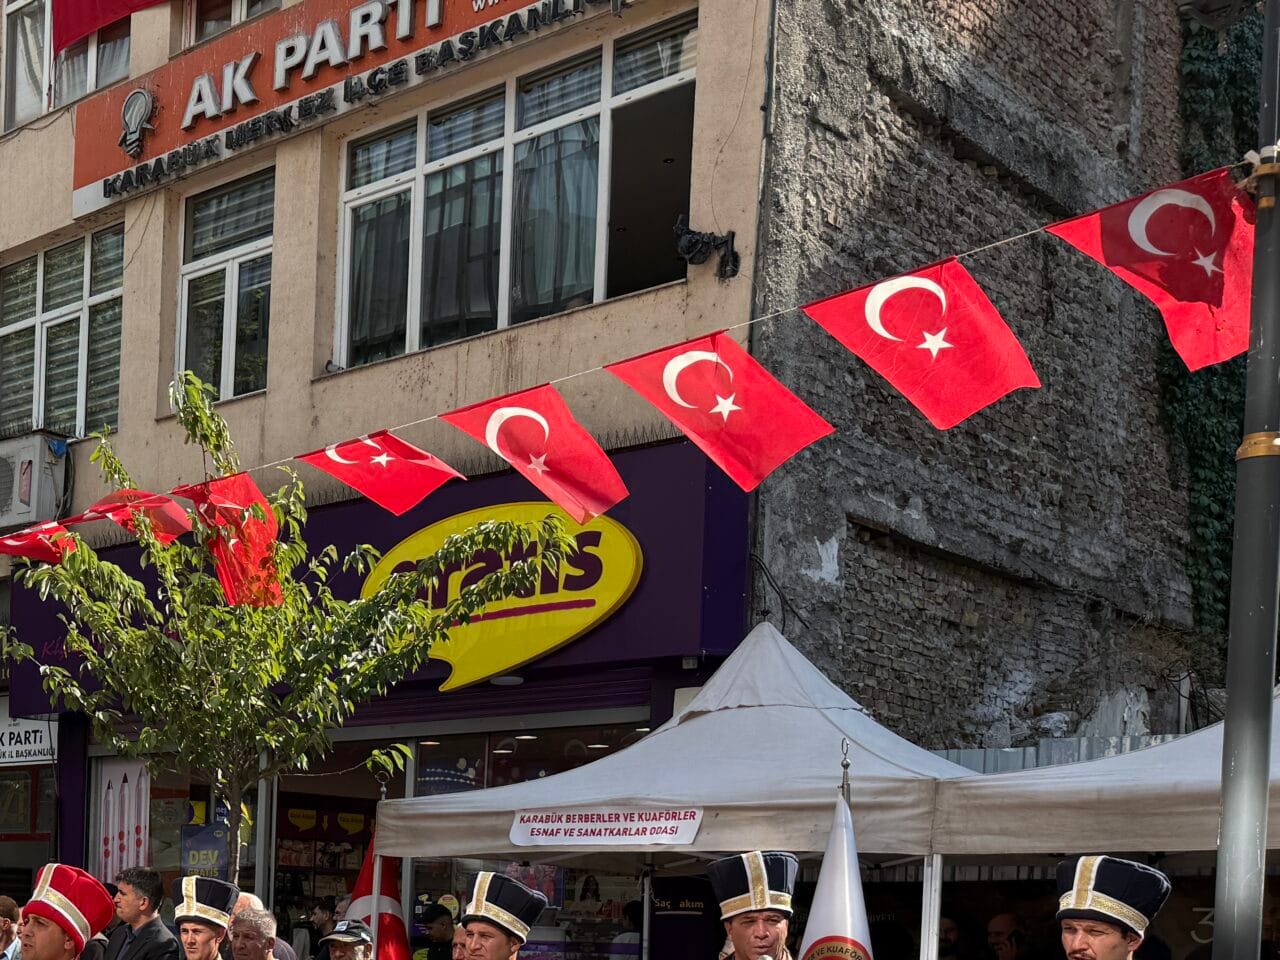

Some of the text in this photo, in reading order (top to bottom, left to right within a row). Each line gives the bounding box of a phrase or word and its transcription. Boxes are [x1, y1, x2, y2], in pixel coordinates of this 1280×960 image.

[181, 52, 262, 131] AK
[103, 132, 220, 198] KARABÜK
[225, 87, 338, 150] MERKEZ
[520, 809, 697, 824] KARABÜK BERBERLER VE KUAFÖRLER
[530, 825, 679, 837] ESNAF VE SANATKARLAR ODASI
[189, 850, 218, 865] DEV
